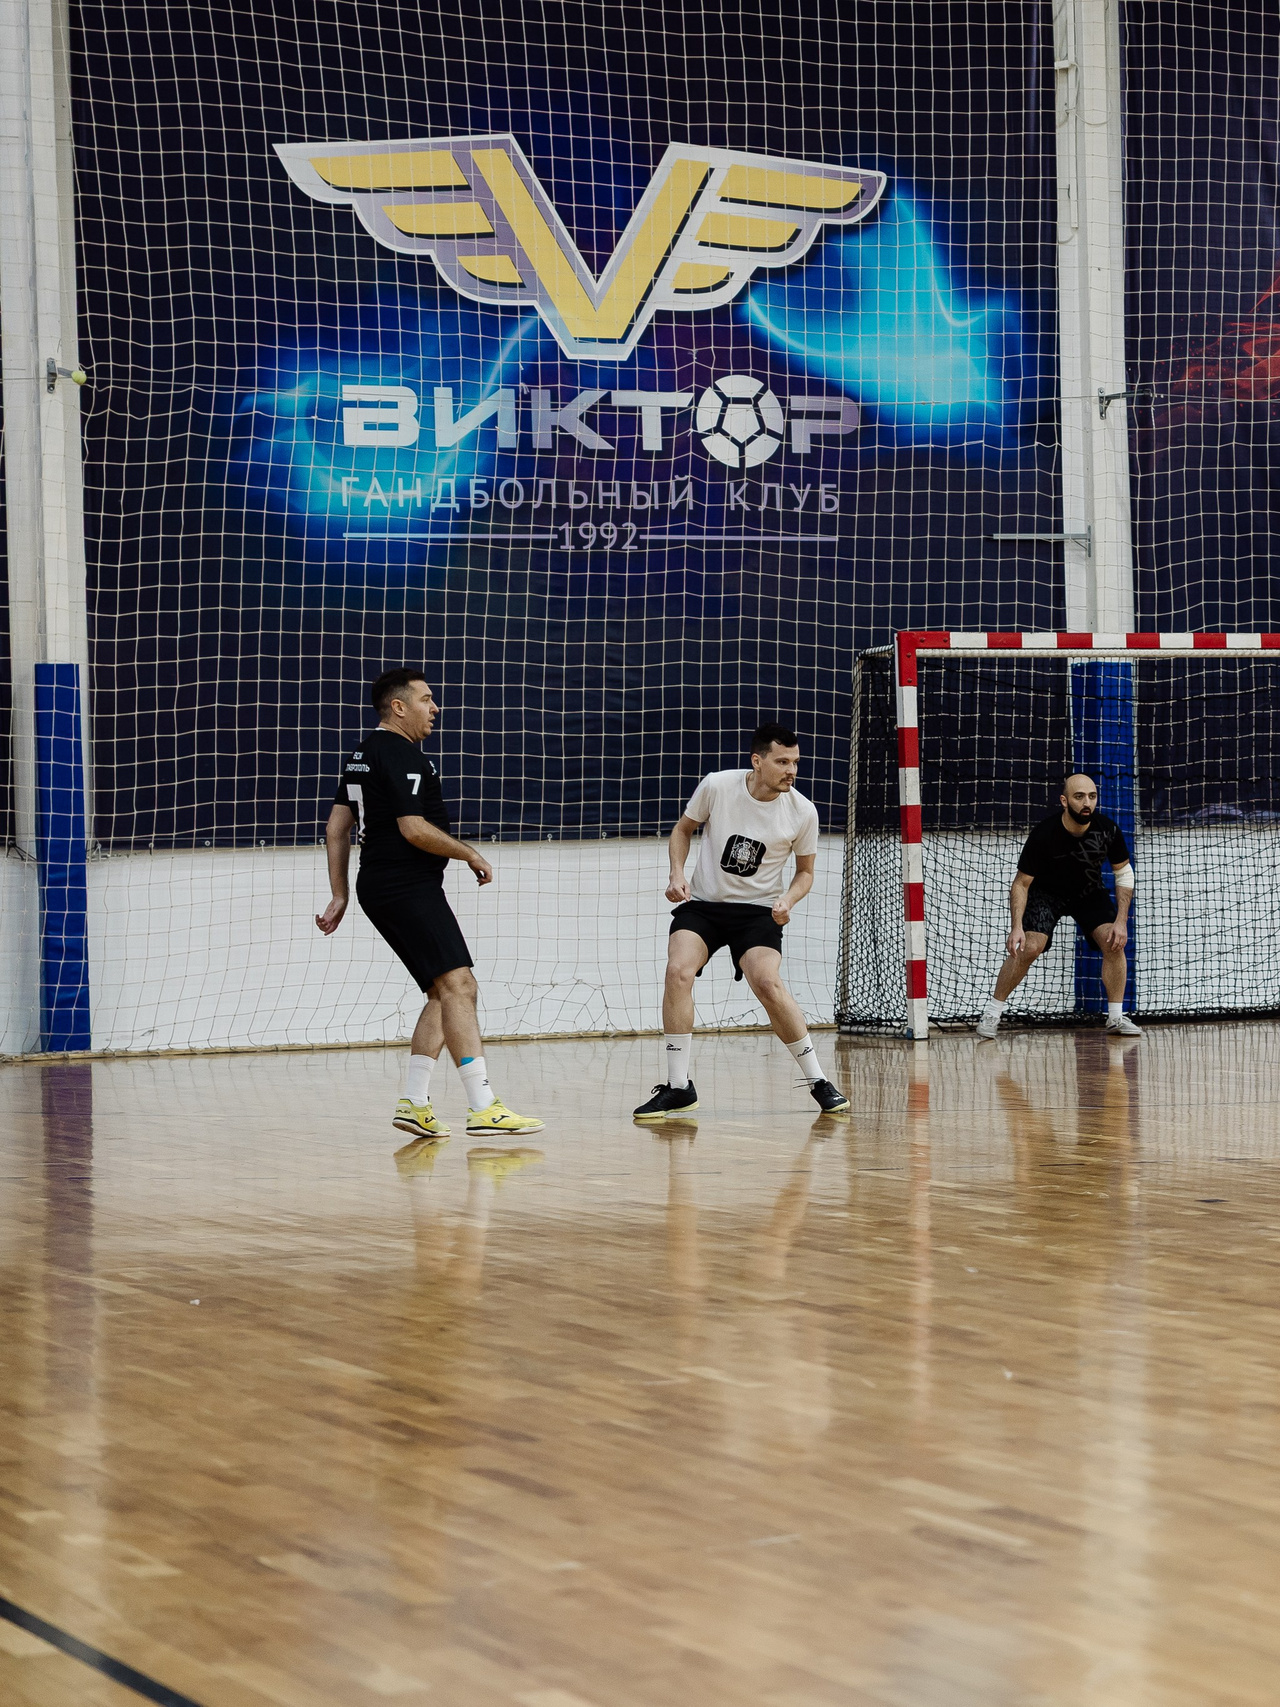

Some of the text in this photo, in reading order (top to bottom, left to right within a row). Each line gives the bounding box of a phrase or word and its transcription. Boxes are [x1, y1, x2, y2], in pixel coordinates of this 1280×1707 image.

[342, 374, 860, 468] ВИКТОР
[340, 474, 840, 513] ГАНДБОЛЬНЫЙ КЛУБ
[558, 521, 639, 550] 1992
[407, 773, 421, 795] 7
